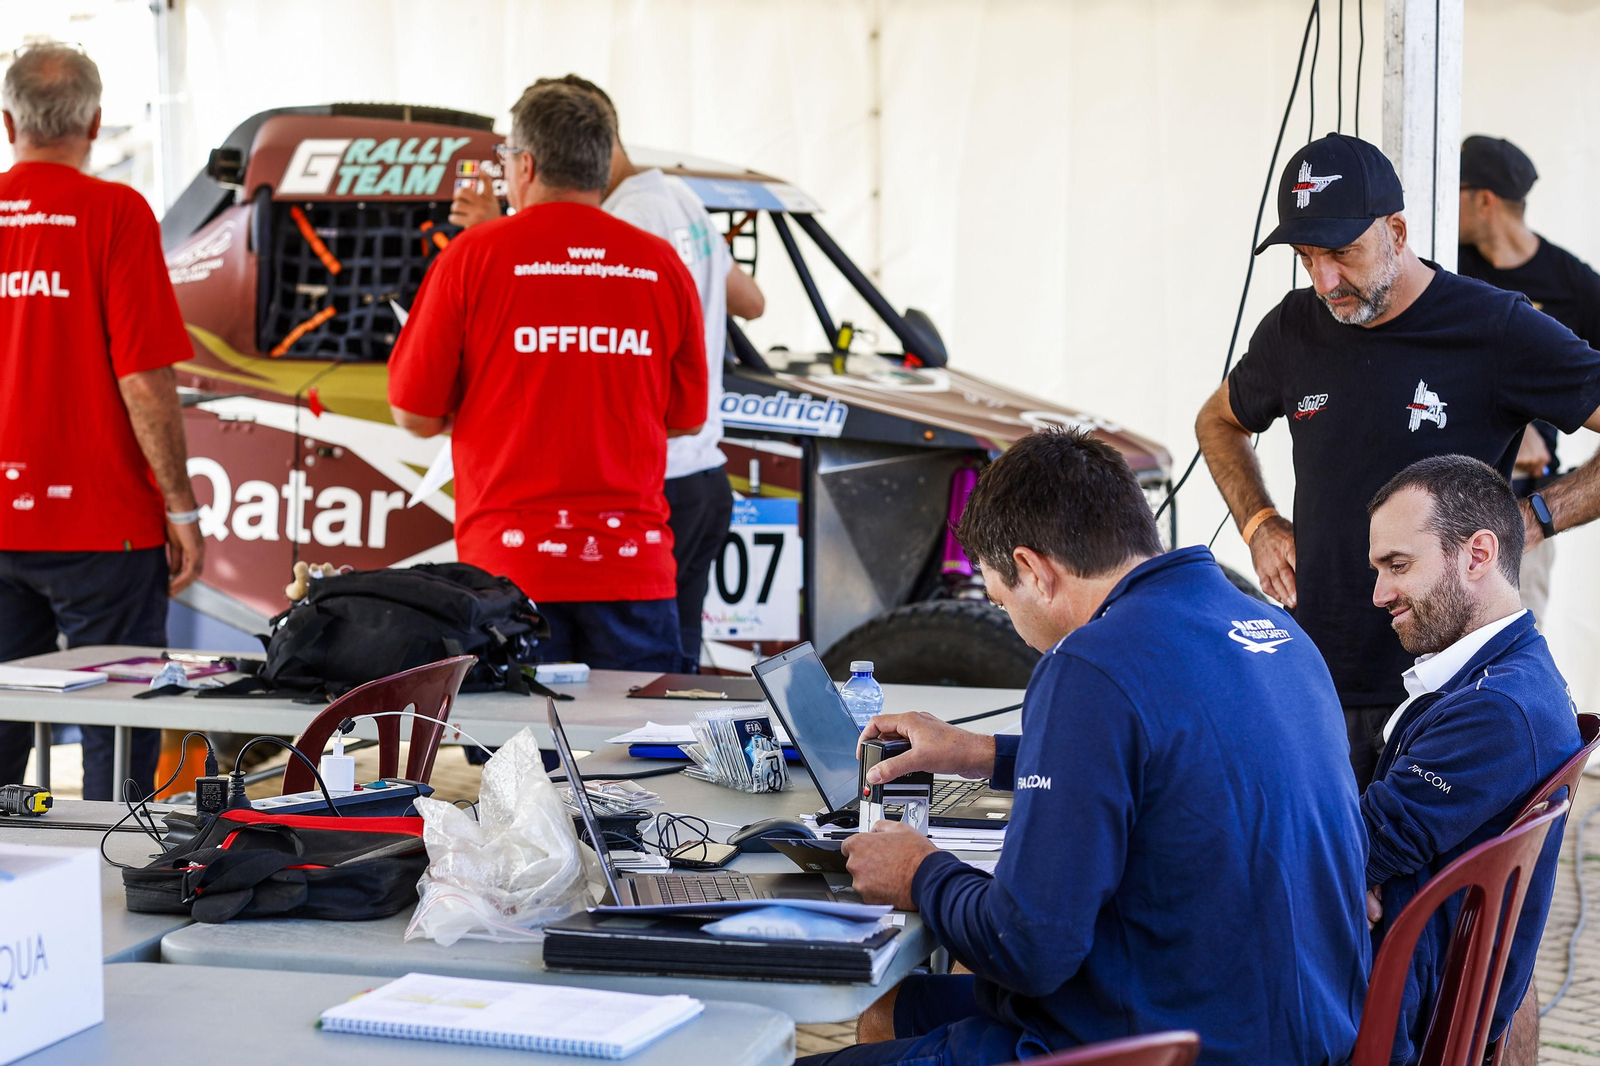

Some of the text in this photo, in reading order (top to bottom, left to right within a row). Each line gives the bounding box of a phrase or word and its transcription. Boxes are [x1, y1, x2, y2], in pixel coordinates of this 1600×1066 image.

[343, 136, 473, 166] RALLY
[335, 164, 447, 196] TEAM
[567, 247, 606, 259] www
[514, 261, 659, 282] andaluciarallyodc.com
[514, 326, 653, 356] OFFICIAL
[720, 393, 847, 425] oodrich
[1297, 393, 1329, 412] JMP
[186, 456, 406, 550] Qatar
[715, 532, 785, 605] 07
[1242, 619, 1276, 631] ACTION
[1267, 629, 1291, 639] SAFETY
[745, 723, 762, 733] FIA
